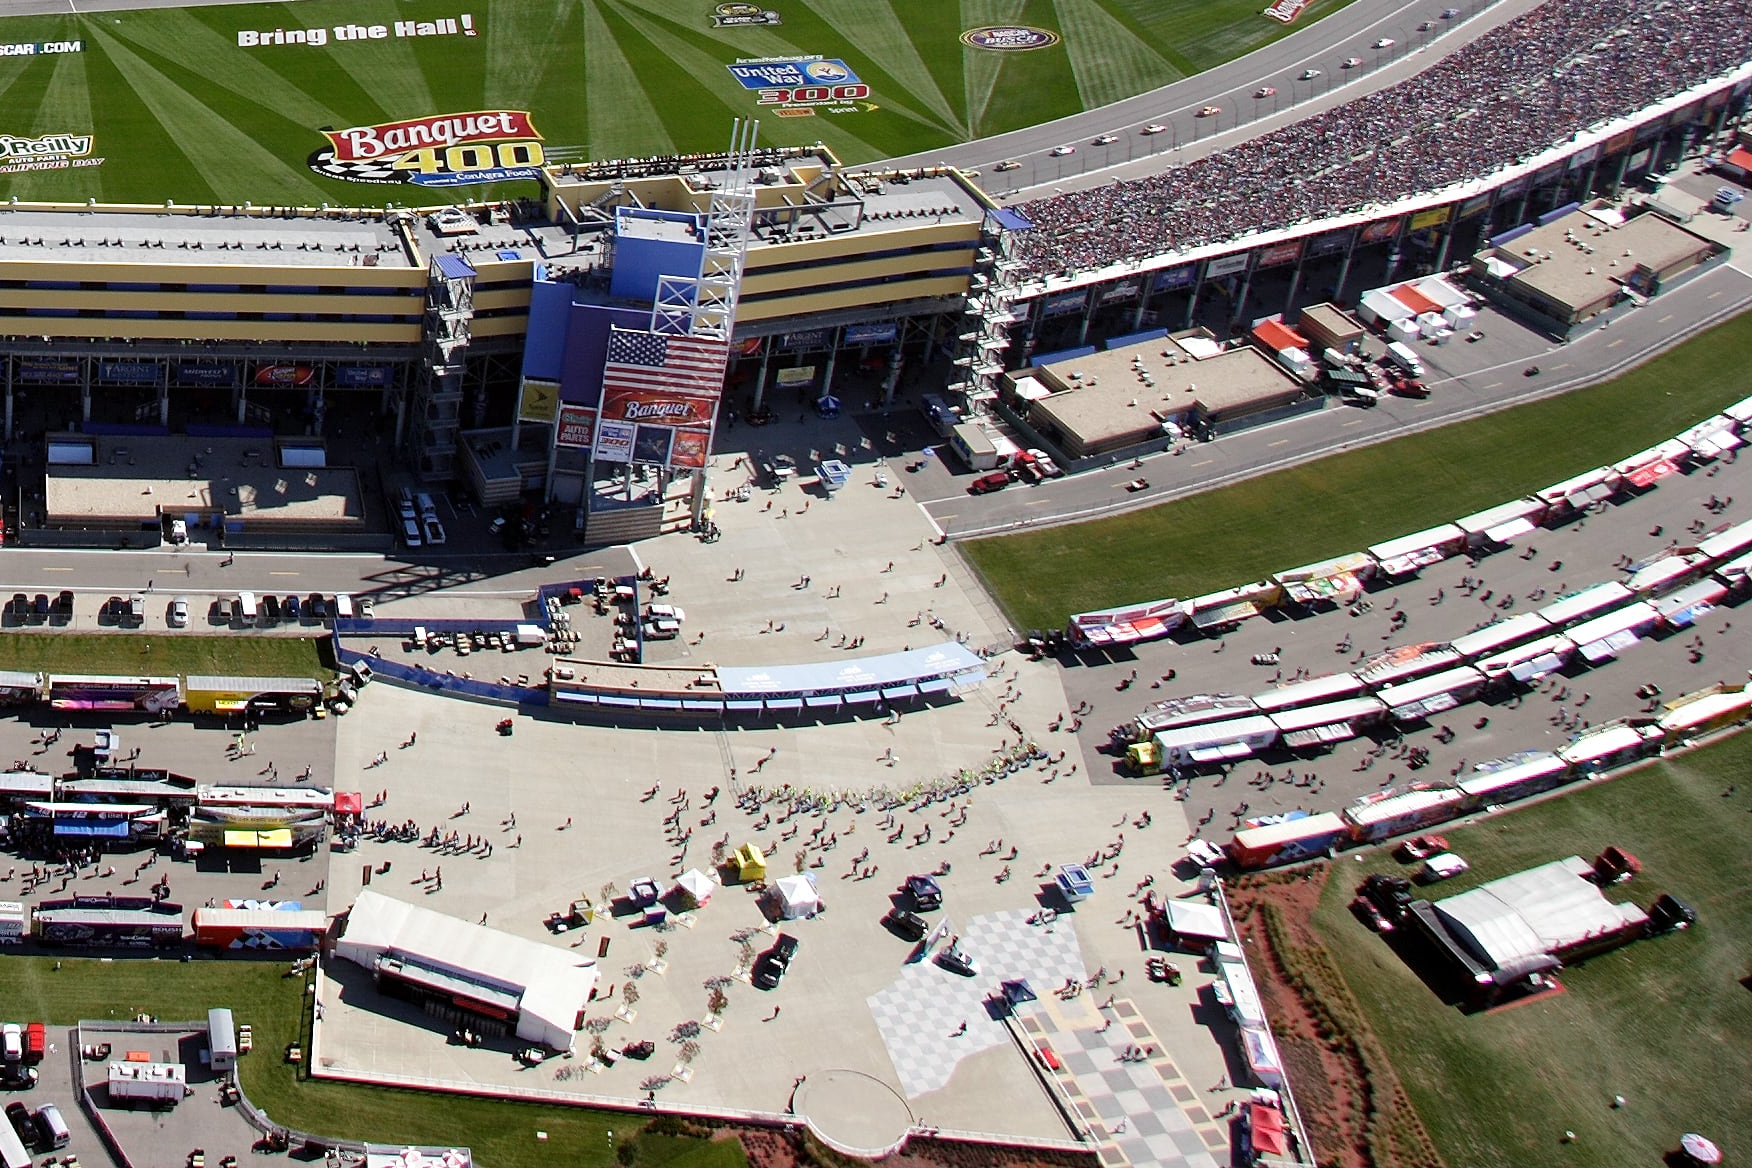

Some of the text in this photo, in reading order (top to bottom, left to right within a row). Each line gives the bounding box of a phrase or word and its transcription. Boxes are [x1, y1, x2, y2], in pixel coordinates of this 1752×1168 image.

[237, 28, 327, 46] Bring
[333, 25, 388, 40] the
[732, 64, 799, 78] United
[763, 74, 805, 85] Way
[757, 84, 870, 105] 300
[828, 107, 859, 115] Sprint
[341, 111, 519, 159] Banquet
[72, 158, 105, 167] DAY
[392, 141, 545, 174] 400
[456, 171, 504, 181] ConAgra
[625, 401, 689, 419] Banquet
[564, 424, 589, 434] AUTO
[560, 433, 589, 443] PARTS
[600, 437, 629, 445] 300
